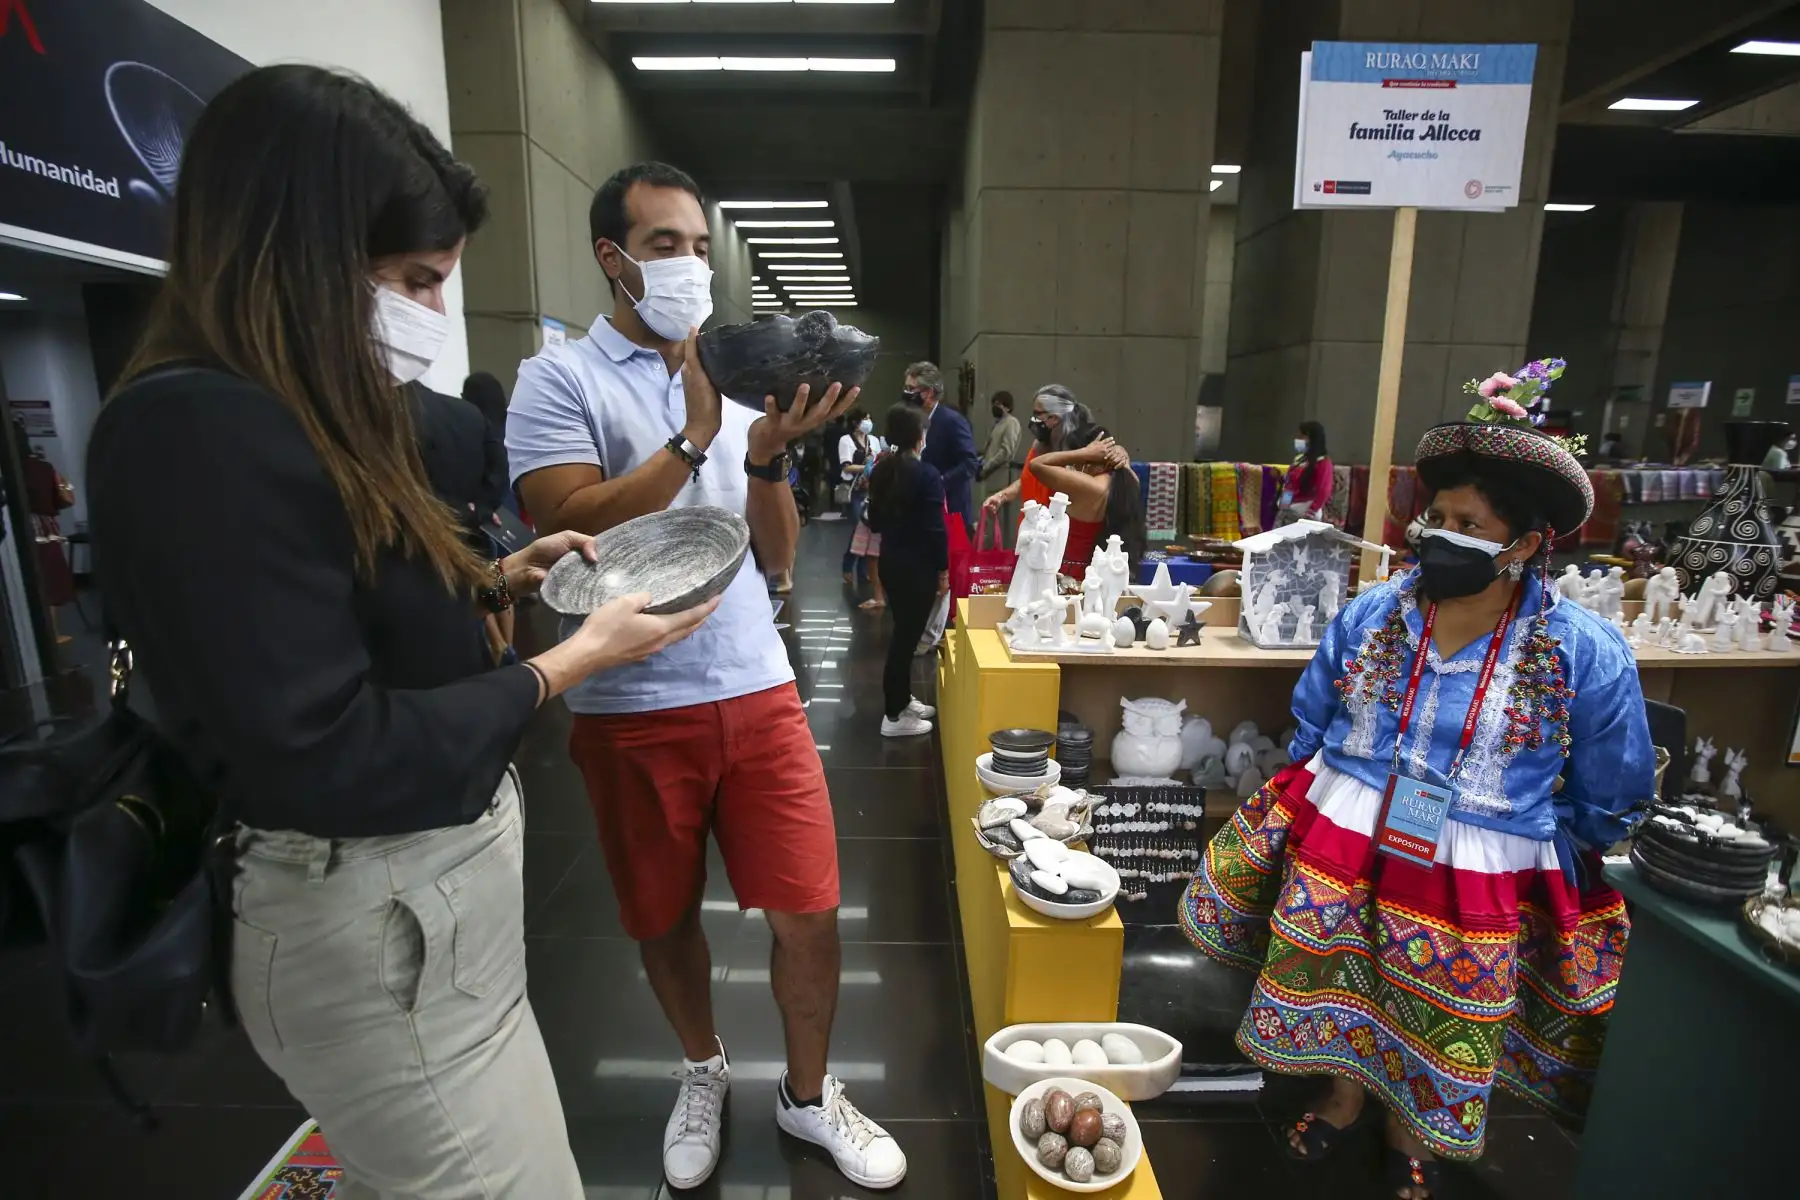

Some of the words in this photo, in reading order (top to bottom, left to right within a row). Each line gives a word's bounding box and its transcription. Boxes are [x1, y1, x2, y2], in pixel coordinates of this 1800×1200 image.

[1365, 52, 1426, 70] RURAQ
[1430, 53, 1481, 70] MAKI
[1383, 109, 1418, 121] Taller
[1420, 110, 1435, 121] de
[1438, 110, 1450, 121] la
[1349, 122, 1415, 141] familia
[1419, 123, 1481, 141] Allcca
[1387, 150, 1439, 161] Ayacucho
[1402, 796, 1442, 816] RURAQ
[1408, 808, 1440, 825] MAKI
[1388, 834, 1430, 854] EXPOSITOR
